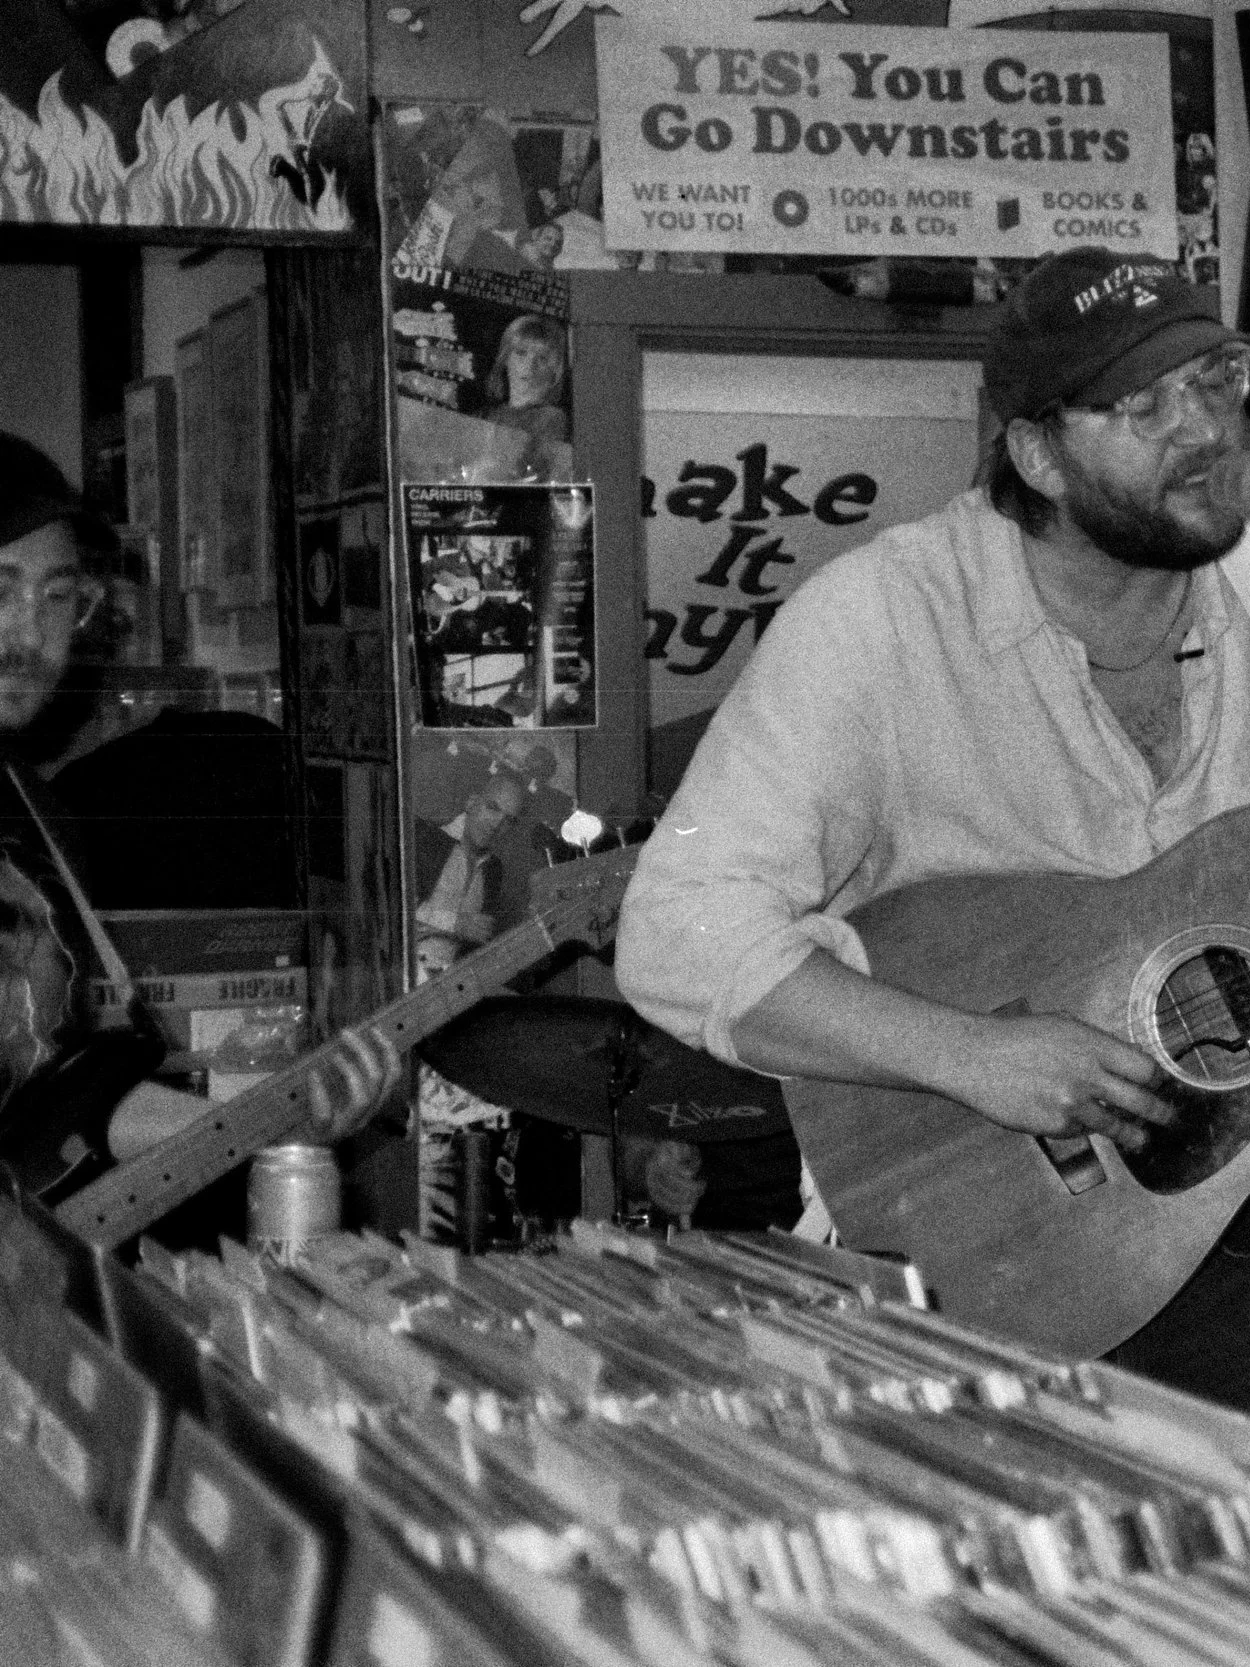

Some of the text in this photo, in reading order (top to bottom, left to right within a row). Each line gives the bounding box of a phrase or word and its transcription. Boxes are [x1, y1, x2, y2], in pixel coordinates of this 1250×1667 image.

[660, 45, 1106, 107] YES! You Can
[641, 103, 1131, 163] Go Downstairs
[631, 182, 751, 204] WE WANT
[829, 187, 973, 209] 1000s MORE
[1042, 190, 1149, 212] BOOKS &
[641, 210, 744, 232] YOU TO!
[844, 215, 958, 237] LPs & CDs
[1053, 218, 1143, 239] COMICS
[408, 489, 484, 502] CARRIERS
[695, 525, 796, 596] It
[220, 978, 297, 1000] FRAGILE
